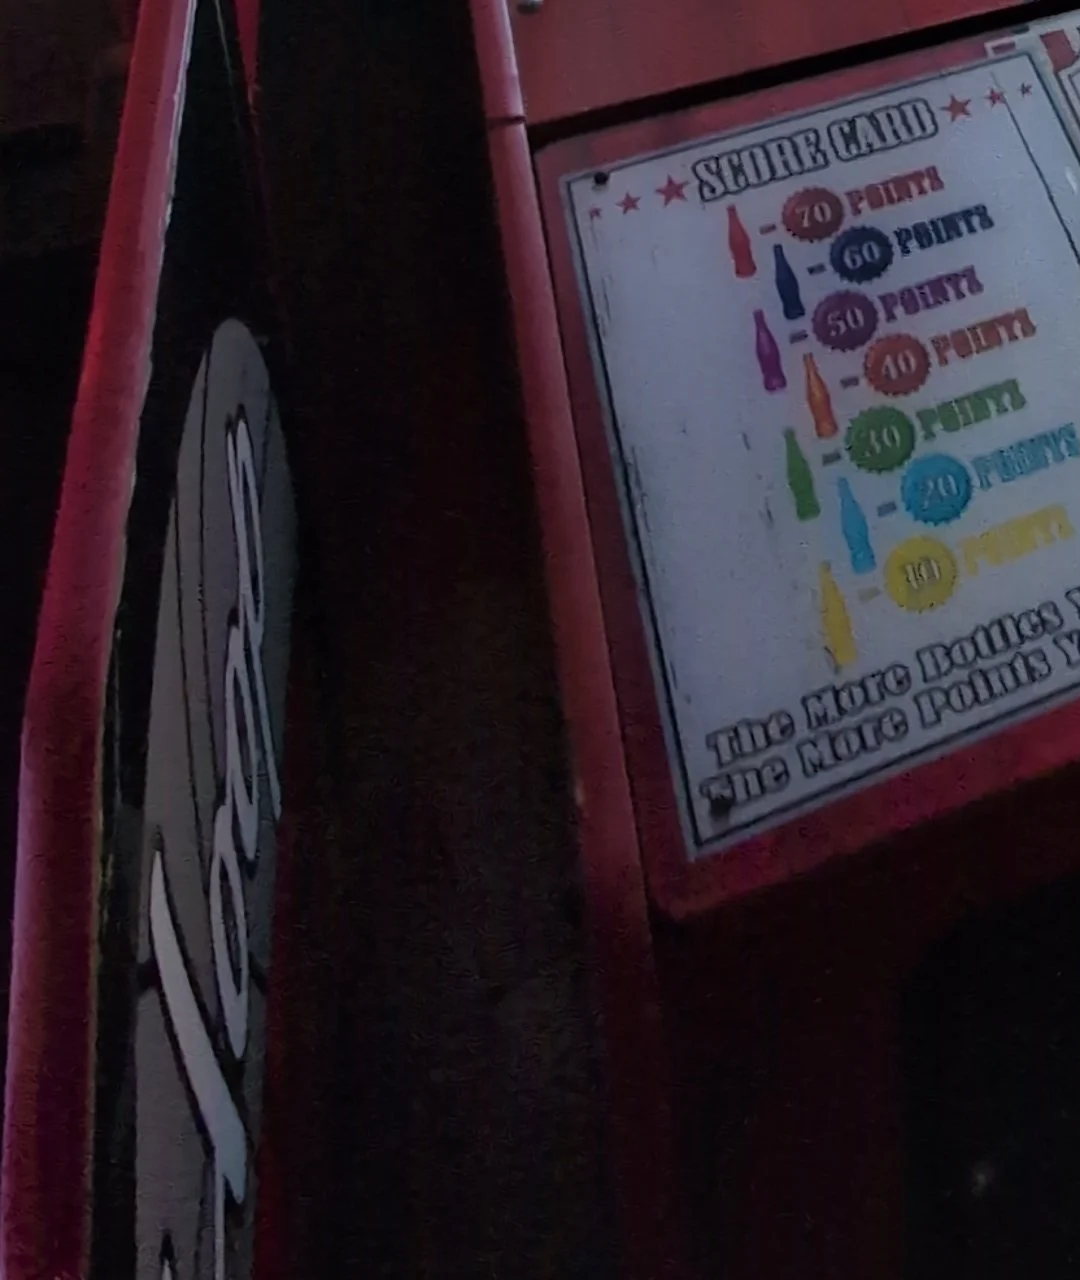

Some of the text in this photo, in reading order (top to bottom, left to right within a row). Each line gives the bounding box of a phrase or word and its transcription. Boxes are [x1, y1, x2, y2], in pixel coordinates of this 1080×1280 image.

[692, 96, 940, 203] SCORE CARD
[798, 164, 945, 229] 70 POINTS
[842, 202, 995, 270] 60 POINTS
[826, 264, 985, 338] 50 POINTS
[880, 307, 1038, 378] 40 POINTS
[915, 377, 1028, 441] POINTS
[706, 709, 796, 768] The
[801, 663, 913, 731] More
[916, 600, 1064, 684] Bottles
[700, 754, 791, 807] The
[795, 706, 910, 779] More
[913, 647, 1053, 729] Points
